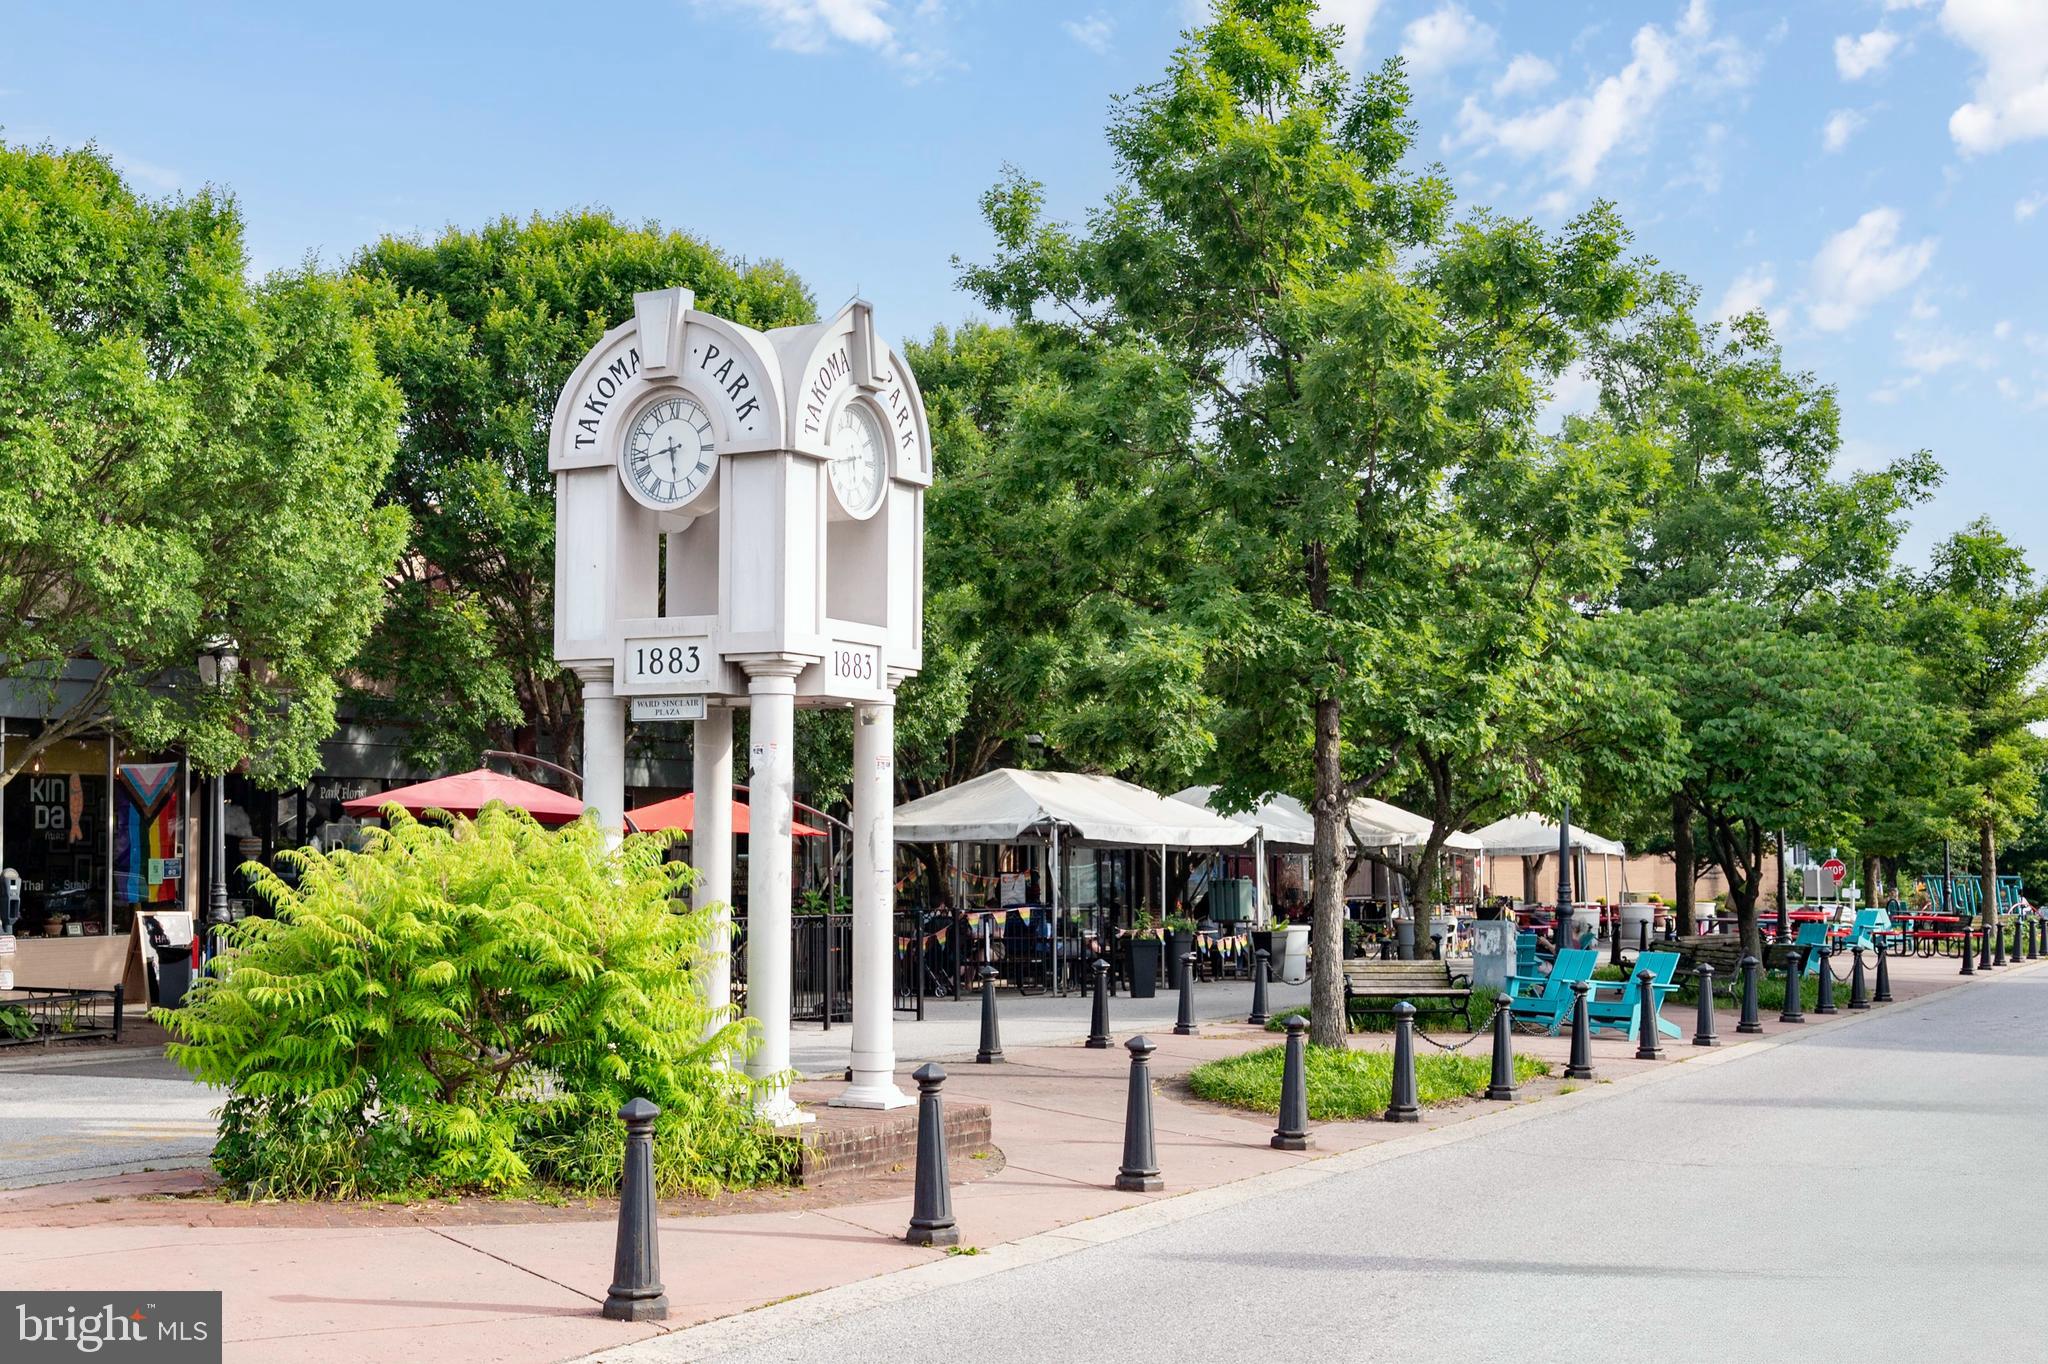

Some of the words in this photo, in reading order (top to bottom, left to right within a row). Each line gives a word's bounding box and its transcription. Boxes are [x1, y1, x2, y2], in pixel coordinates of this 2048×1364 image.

[574, 347, 641, 449] TAKOMA
[700, 343, 760, 423] PARK
[804, 347, 850, 434] TAKOMA
[637, 646, 700, 675] 1883
[835, 651, 871, 680] 1883
[637, 700, 660, 708] WARD
[662, 698, 699, 707] SINCLAIR
[655, 708, 680, 716] PLAZA
[320, 782, 340, 801] Park
[22, 880, 44, 891] Thai
